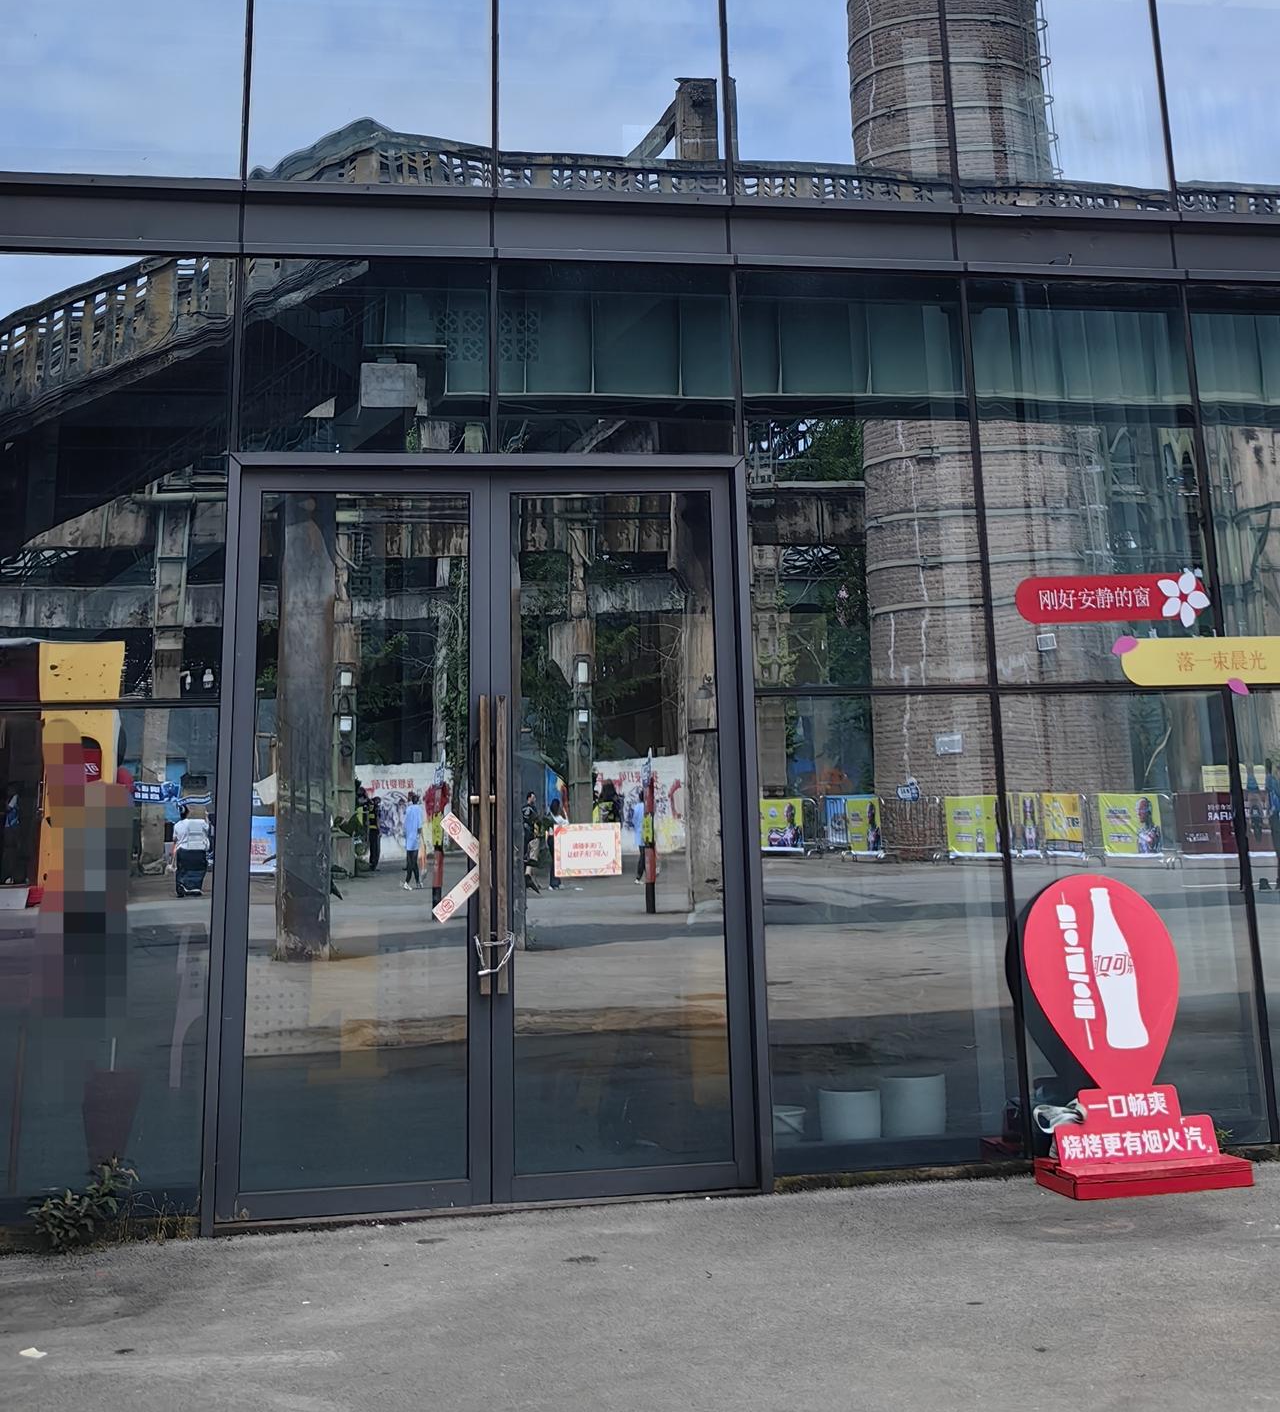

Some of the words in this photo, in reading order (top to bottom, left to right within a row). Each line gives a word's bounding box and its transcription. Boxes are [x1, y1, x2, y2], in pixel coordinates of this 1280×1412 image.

[1038, 586, 1151, 611] 刚好安静的窗
[1176, 649, 1268, 673] 落一束晨光
[1088, 1091, 1169, 1118] 一口畅爽
